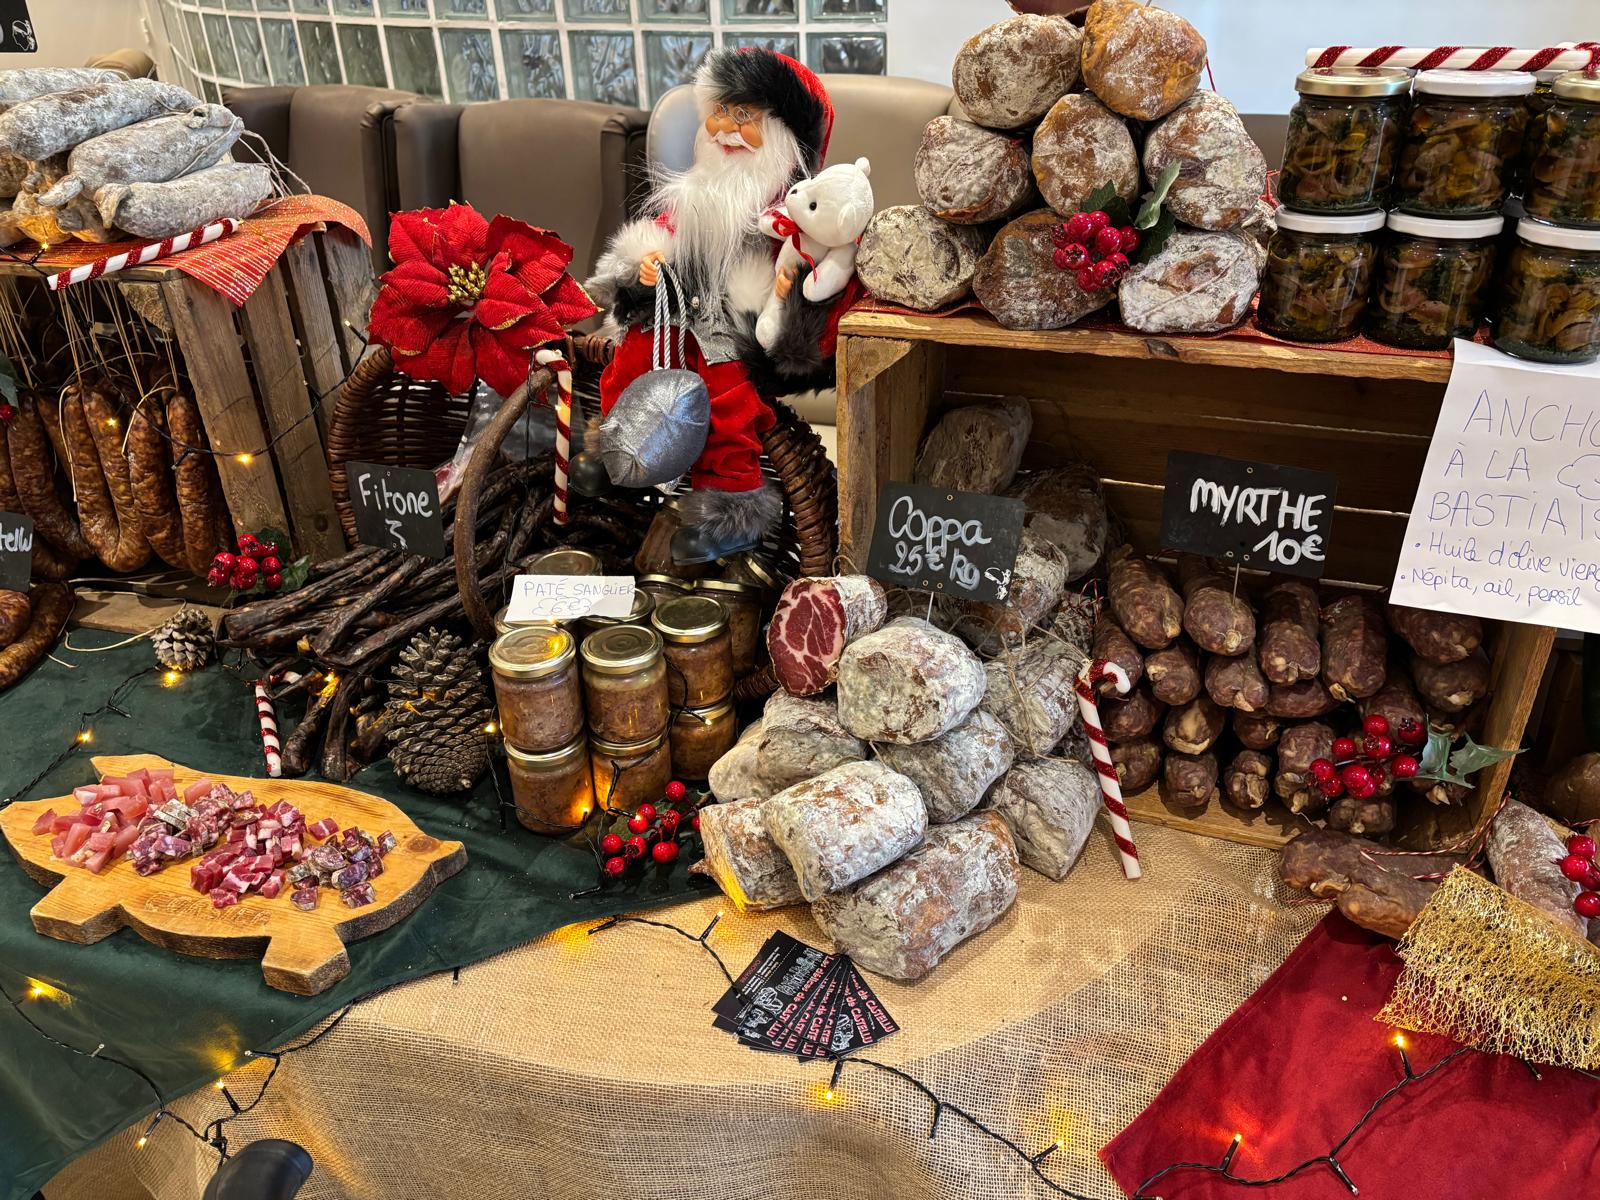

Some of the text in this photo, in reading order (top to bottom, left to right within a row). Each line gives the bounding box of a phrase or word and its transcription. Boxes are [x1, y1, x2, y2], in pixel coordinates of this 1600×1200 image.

[1444, 441, 1531, 482] À LA
[1189, 477, 1327, 533] MYRTHE
[888, 495, 993, 558] Coppa
[887, 540, 945, 577] 25€
[1252, 529, 1326, 566] 10€
[1428, 531, 1482, 563] Huile
[1488, 540, 1553, 574] d'olive
[523, 577, 569, 598] PATÉ
[1483, 578, 1522, 603] ail,
[1528, 585, 1585, 608] persil
[766, 1003, 799, 1039] CASTLLU
[850, 1008, 874, 1044] CASTELLU
[865, 1000, 896, 1033] CASTELLU
